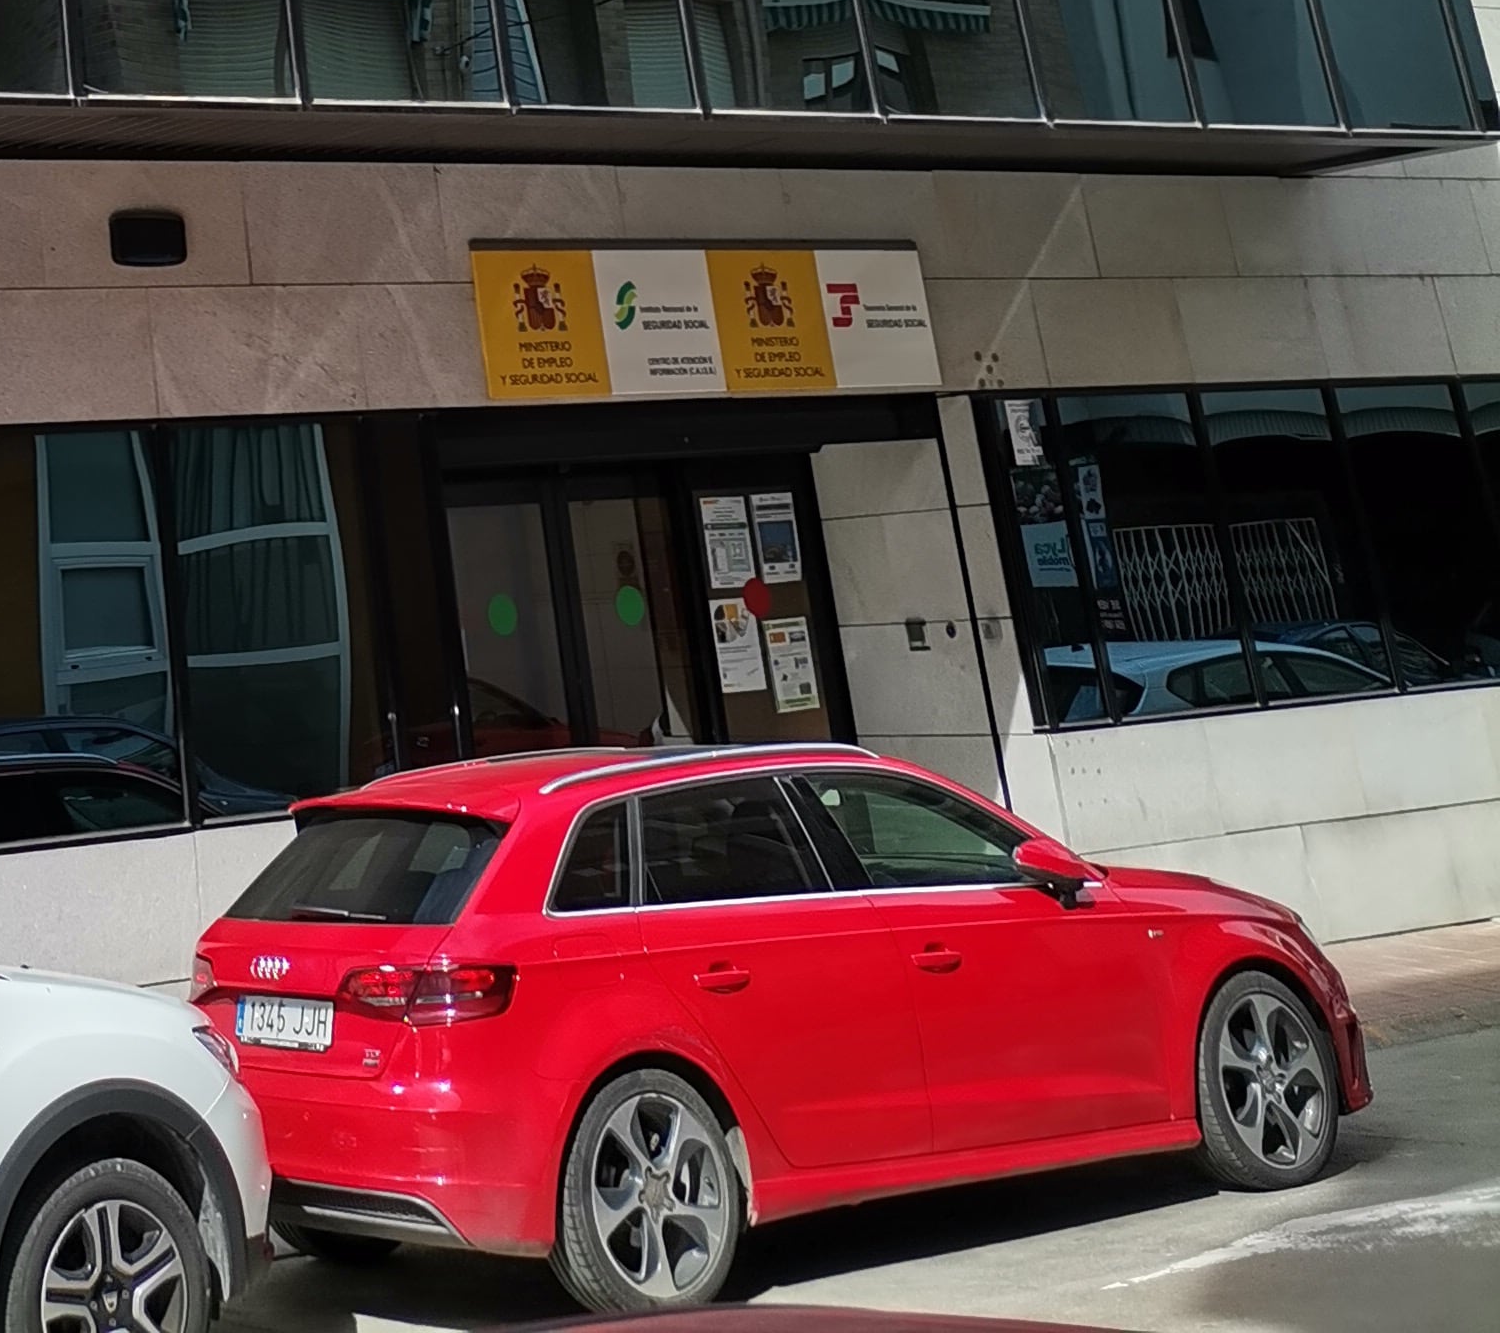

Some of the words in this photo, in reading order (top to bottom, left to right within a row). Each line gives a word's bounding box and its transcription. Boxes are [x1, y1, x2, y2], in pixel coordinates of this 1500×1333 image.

[641, 319, 682, 330] SEGURIDAD
[683, 319, 710, 329] SOCIAL
[518, 340, 572, 352] MINISTERIO
[750, 336, 800, 347] MINISTERIO
[522, 357, 534, 369] DE
[537, 356, 573, 368] EMPLEO
[754, 351, 767, 362] DE
[768, 351, 802, 362] EMPLEO
[734, 368, 741, 378] Y
[743, 367, 793, 378] SEGURIDAD
[793, 366, 825, 377] SOCIAL
[499, 375, 507, 386] Y
[509, 373, 563, 386] SEGURIDAD
[564, 372, 599, 384] SOCIAL
[250, 1000, 285, 1033] 1345
[293, 1006, 328, 1037] JJH
